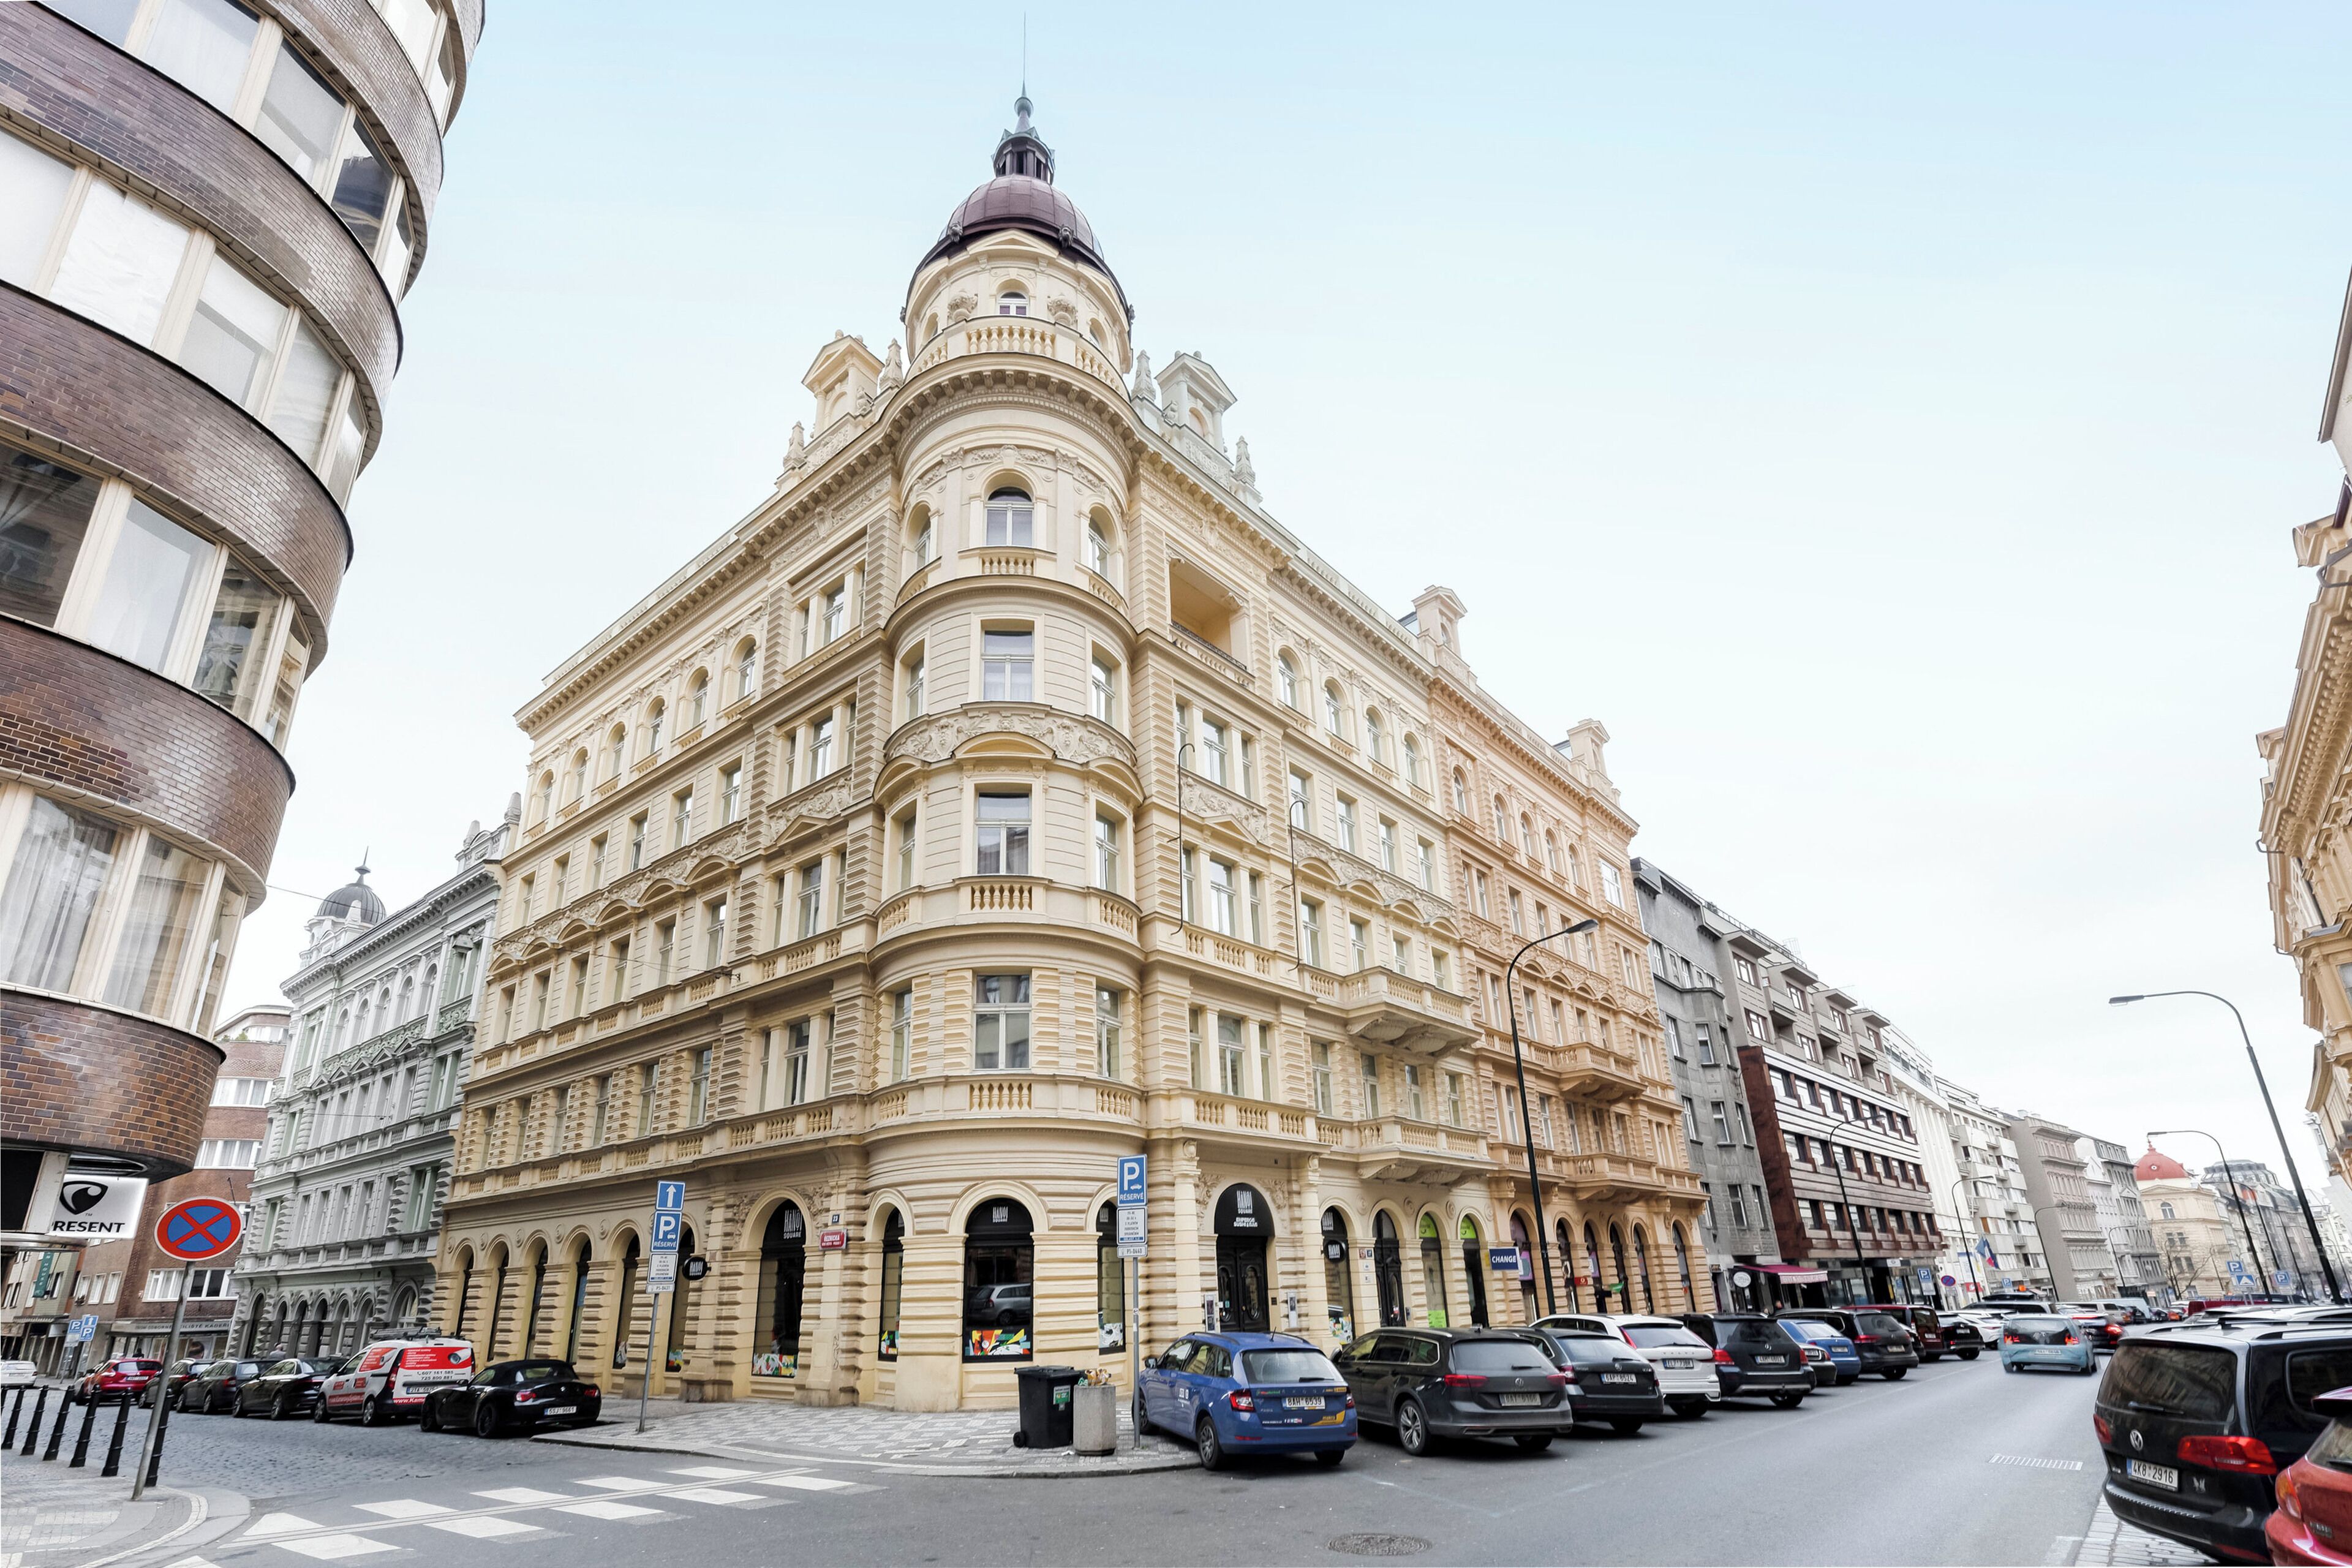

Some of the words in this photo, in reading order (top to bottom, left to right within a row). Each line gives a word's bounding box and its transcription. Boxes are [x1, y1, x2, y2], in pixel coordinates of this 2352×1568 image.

[1120, 1193, 1144, 1201] RÉSERVÉ
[52, 1221, 125, 1233] RESENT
[2133, 1461, 2147, 1476] 4K8
[2152, 1466, 2174, 1484] 2916
